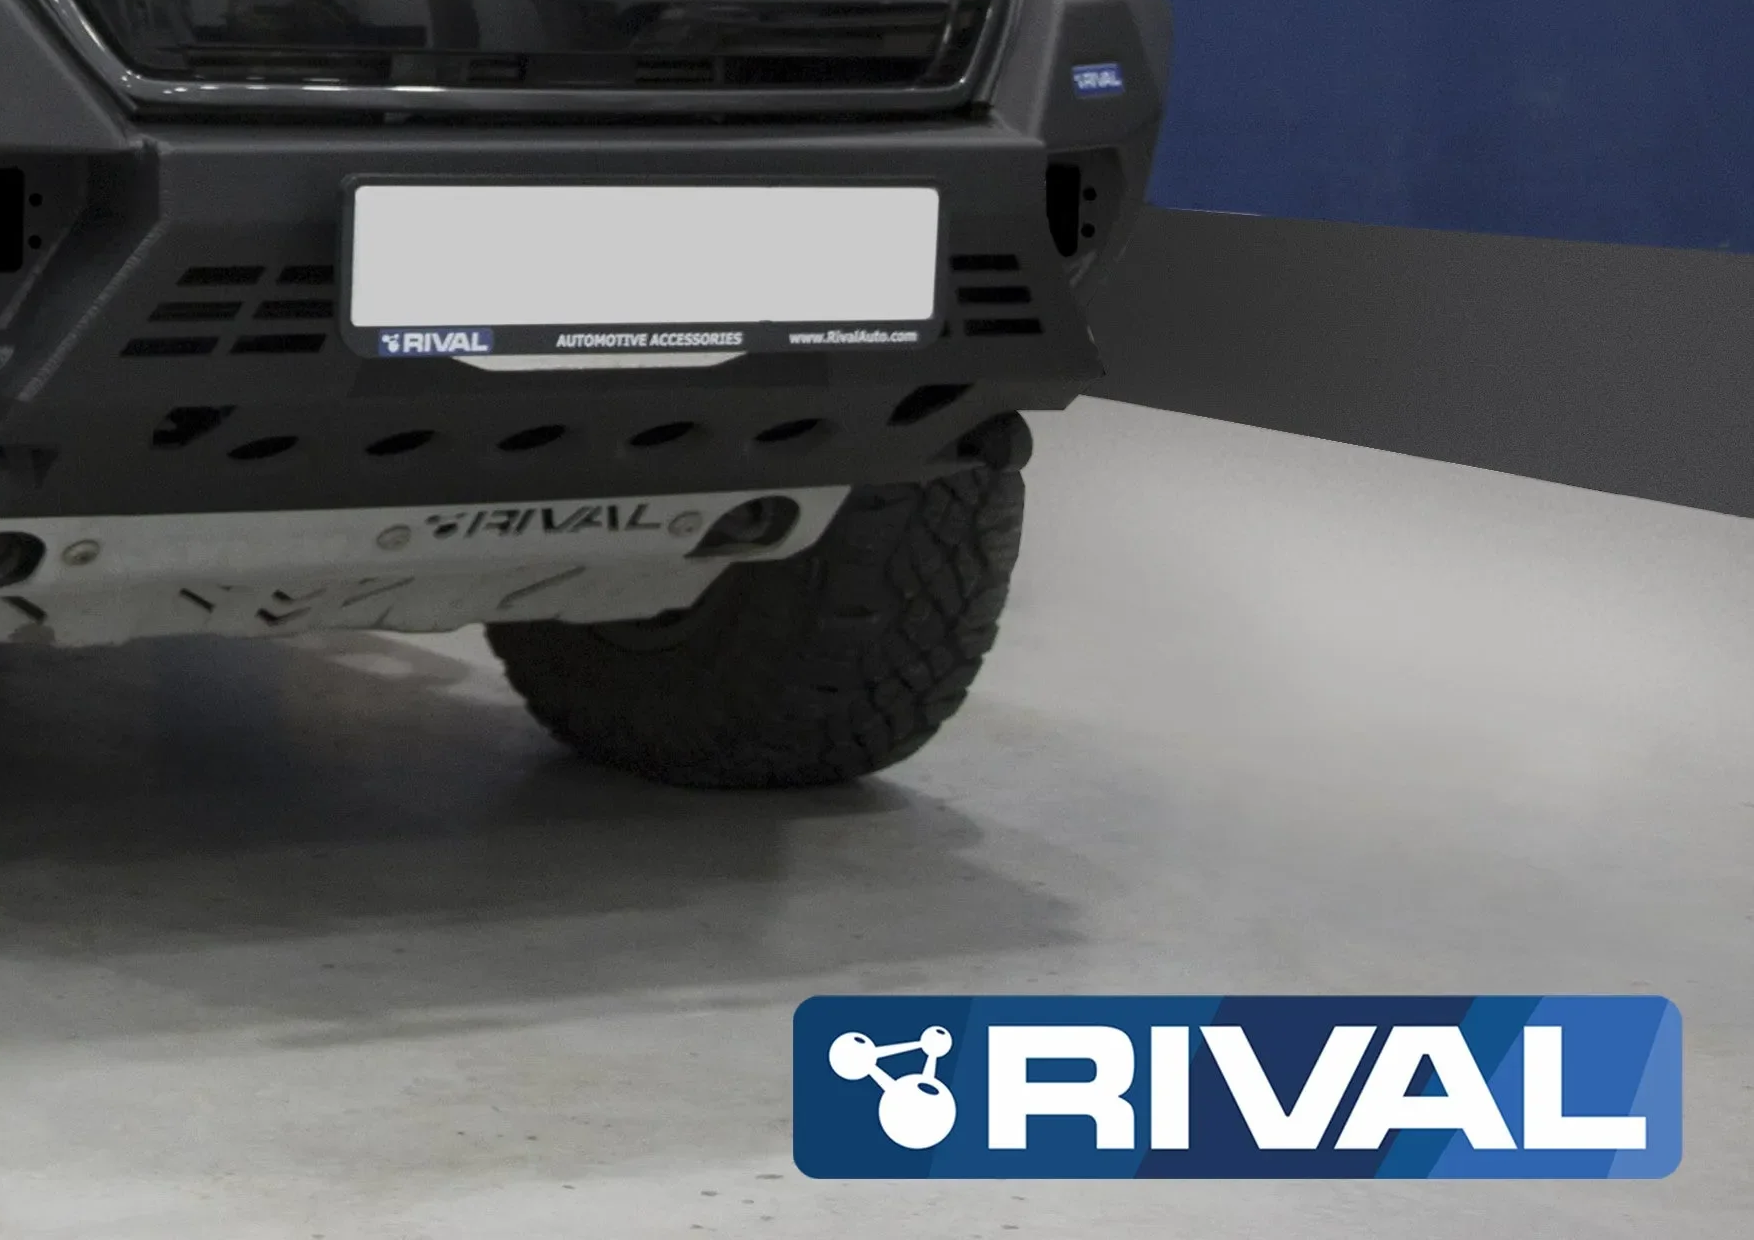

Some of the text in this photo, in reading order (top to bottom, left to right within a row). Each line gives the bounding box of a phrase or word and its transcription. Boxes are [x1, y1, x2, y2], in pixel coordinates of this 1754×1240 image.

[402, 331, 489, 353] RIVAL
[555, 331, 744, 348] AUTOMOTIVE ACCESSORIES
[788, 329, 918, 345] www.RivalAuto.com
[463, 503, 661, 539] RIVAL
